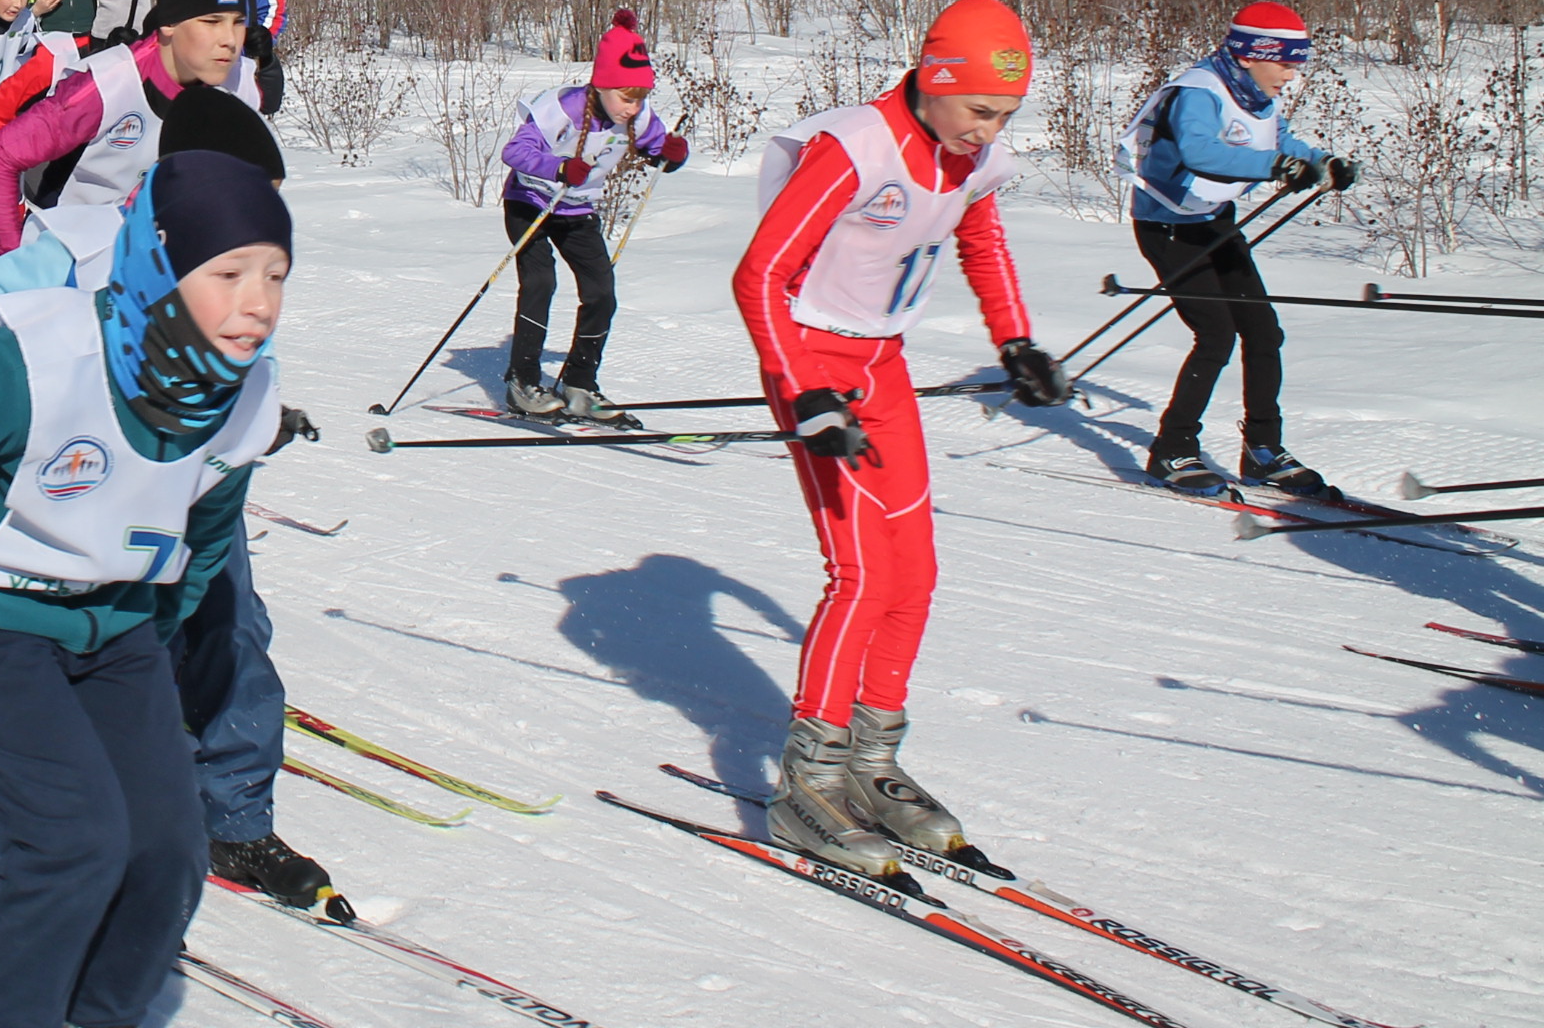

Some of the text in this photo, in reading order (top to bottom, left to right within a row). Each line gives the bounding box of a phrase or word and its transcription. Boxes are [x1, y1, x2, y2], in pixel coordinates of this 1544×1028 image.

[123, 526, 184, 584] 7
[810, 863, 910, 914] ROSSIGNOL
[894, 845, 978, 889] OSSIGNOL
[1089, 918, 1283, 1002] ROSSIGNOL
